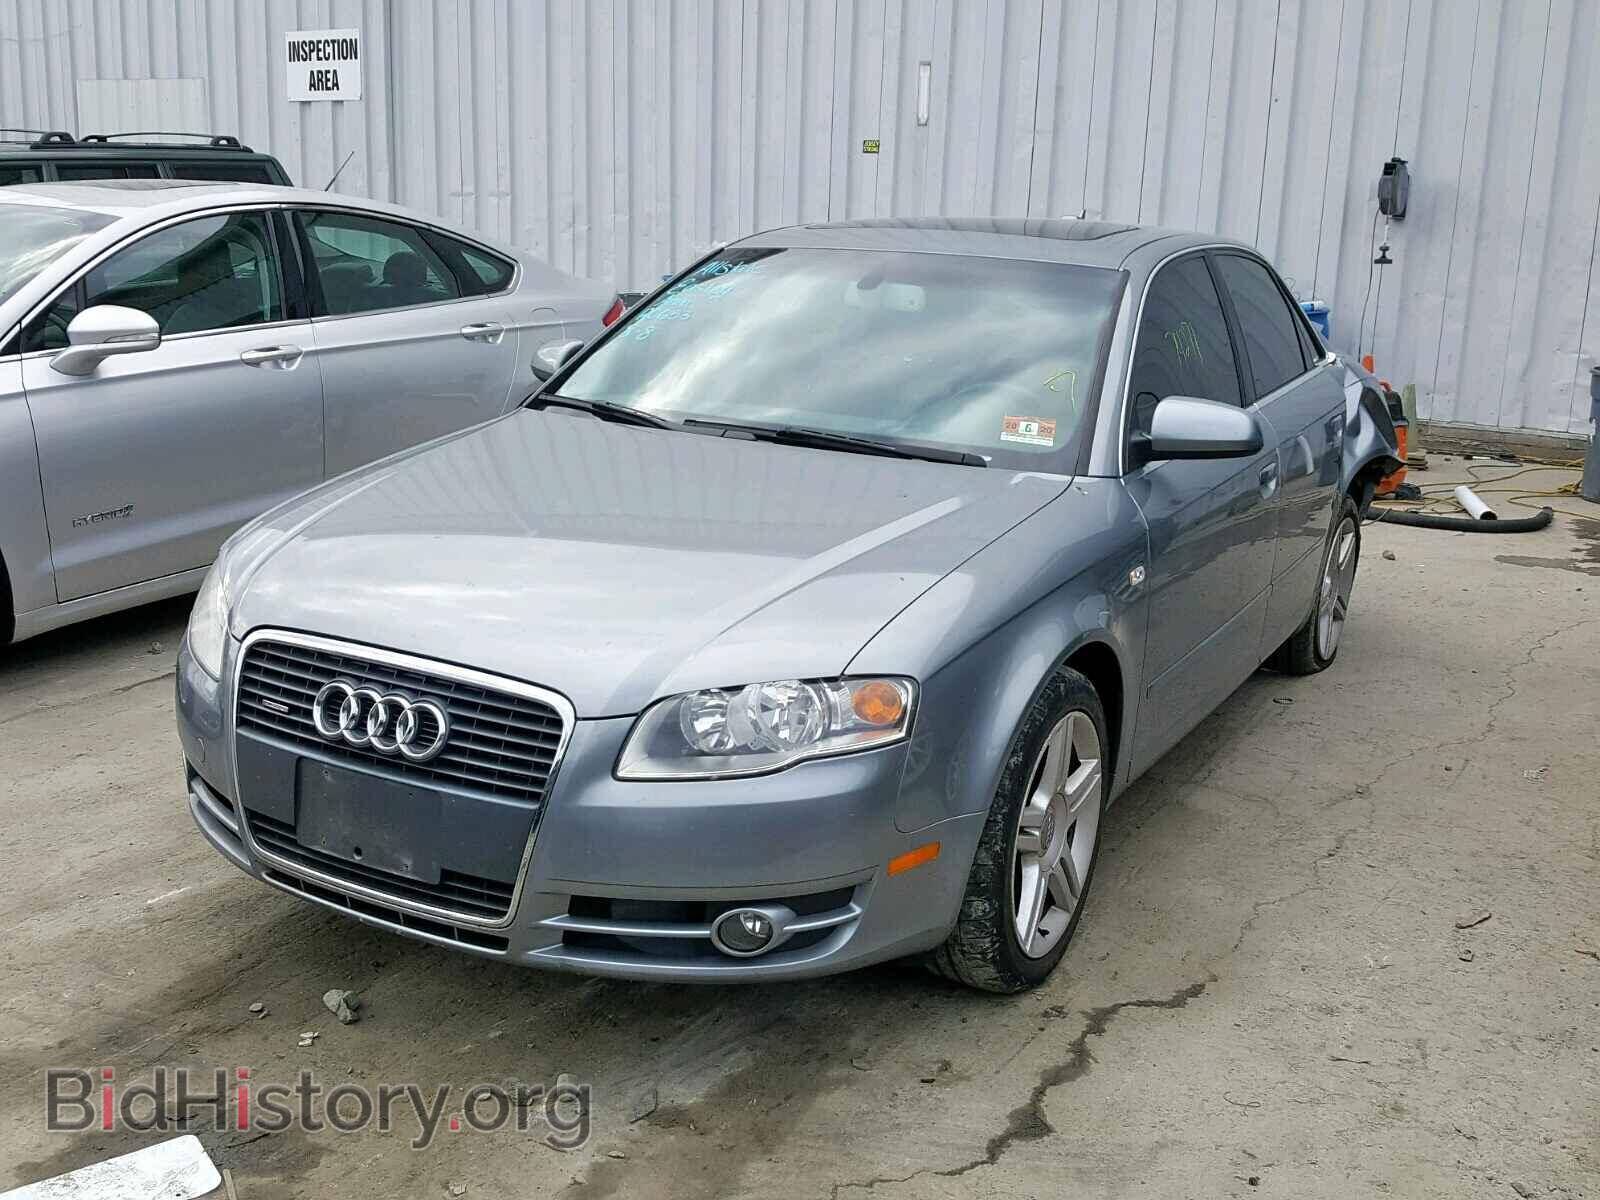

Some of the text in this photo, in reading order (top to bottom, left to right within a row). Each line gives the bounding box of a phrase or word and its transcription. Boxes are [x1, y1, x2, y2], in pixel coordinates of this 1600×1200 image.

[288, 38, 358, 62] INSPECTION
[309, 69, 339, 91] AREA
[1024, 423, 1032, 432] 6
